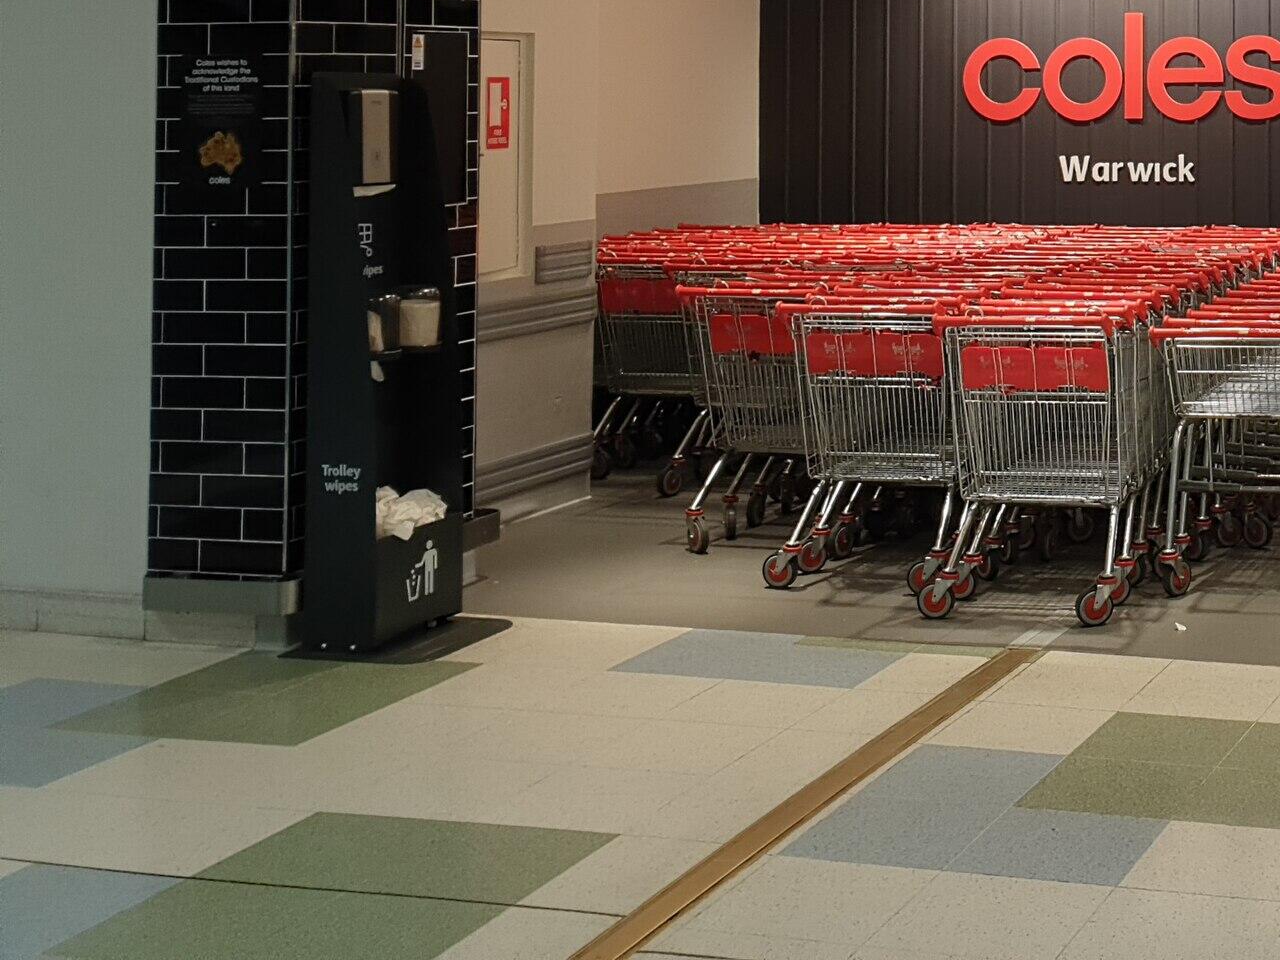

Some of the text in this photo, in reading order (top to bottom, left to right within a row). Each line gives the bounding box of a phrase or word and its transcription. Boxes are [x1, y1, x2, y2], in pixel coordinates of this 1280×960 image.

[1058, 153, 1196, 184] Warwick
[208, 176, 231, 185] coles
[321, 464, 361, 480] Trolley
[324, 480, 359, 495] wipes
